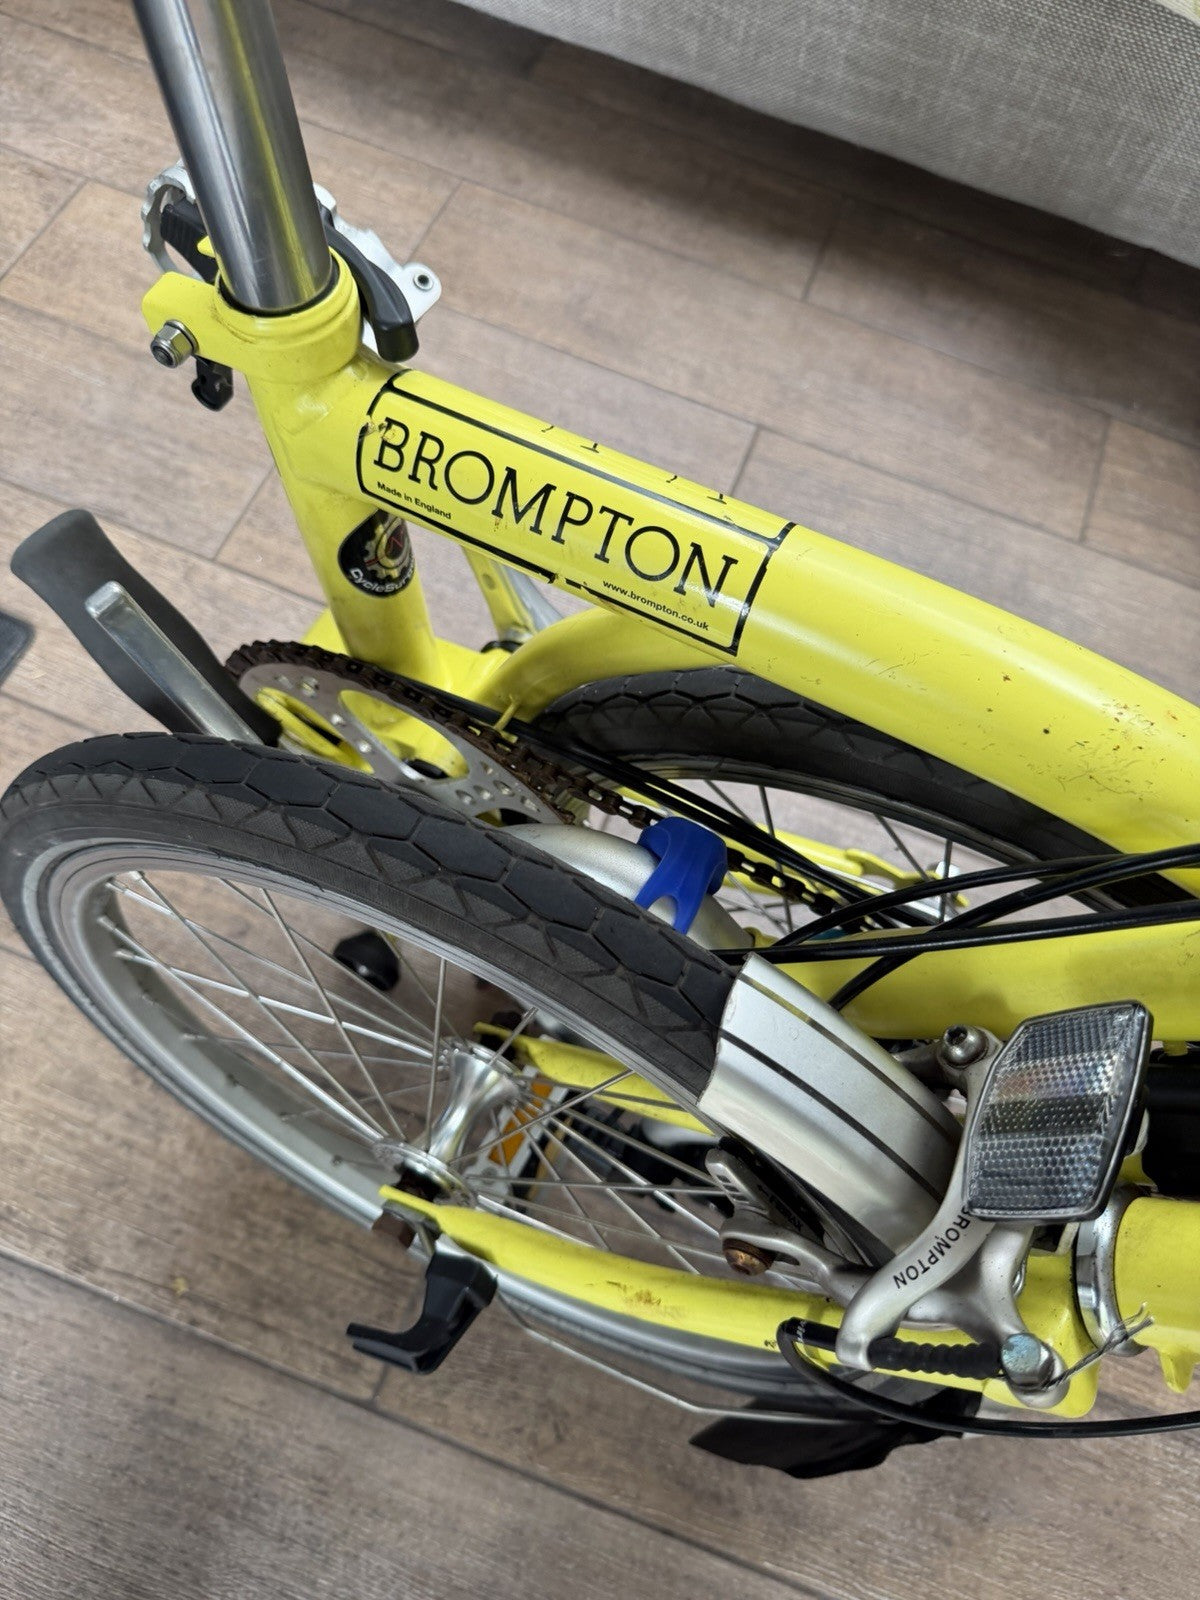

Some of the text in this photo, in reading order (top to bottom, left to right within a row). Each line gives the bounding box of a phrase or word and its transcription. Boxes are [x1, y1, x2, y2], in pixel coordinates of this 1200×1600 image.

[373, 416, 738, 608] BROMPTON
[377, 481, 452, 520] Made in England
[602, 580, 709, 631] www.brompton.co.uk
